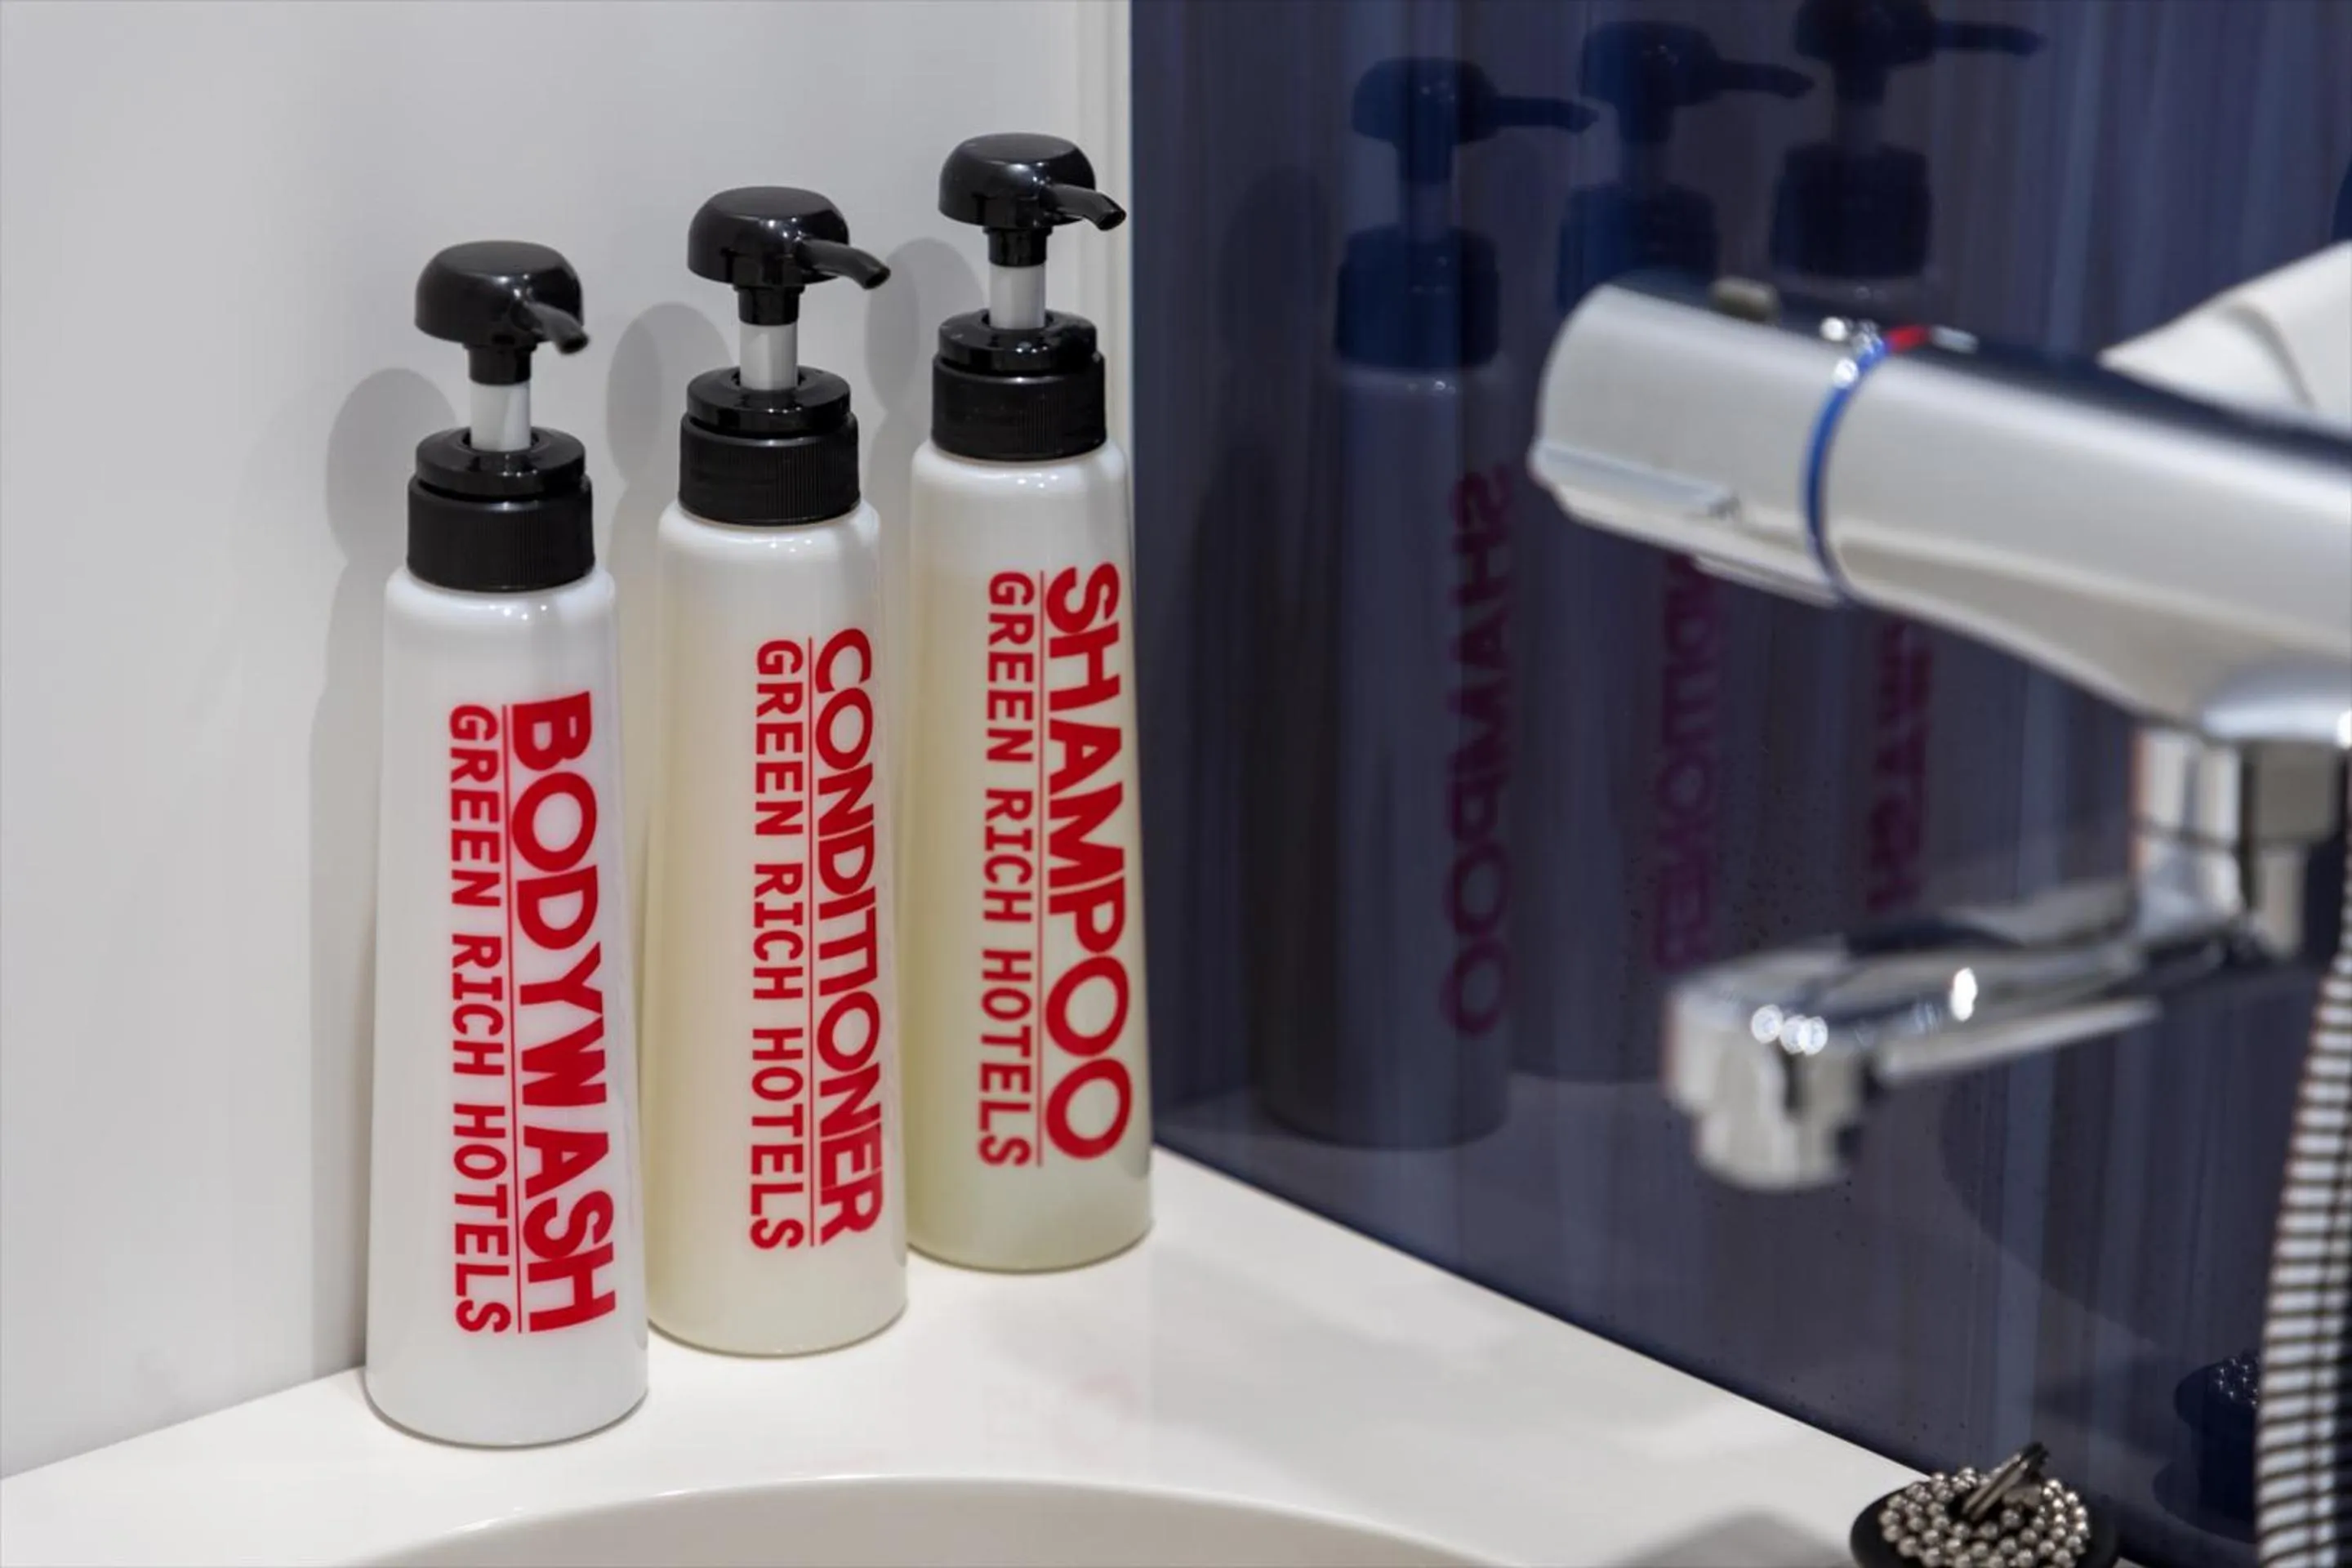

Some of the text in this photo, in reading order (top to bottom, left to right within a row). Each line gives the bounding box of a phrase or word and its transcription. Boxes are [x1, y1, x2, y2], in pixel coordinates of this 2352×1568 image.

[448, 702, 512, 1334] GREEN RICH HOTELS
[510, 690, 617, 1334] BODYWASH
[748, 639, 806, 1251] GREEN RICH HOTELS
[813, 628, 884, 1245] CONDITIONER
[978, 571, 1037, 1167] GREEN RICH HOTELS
[1042, 563, 1133, 1160] SHAMPOO
